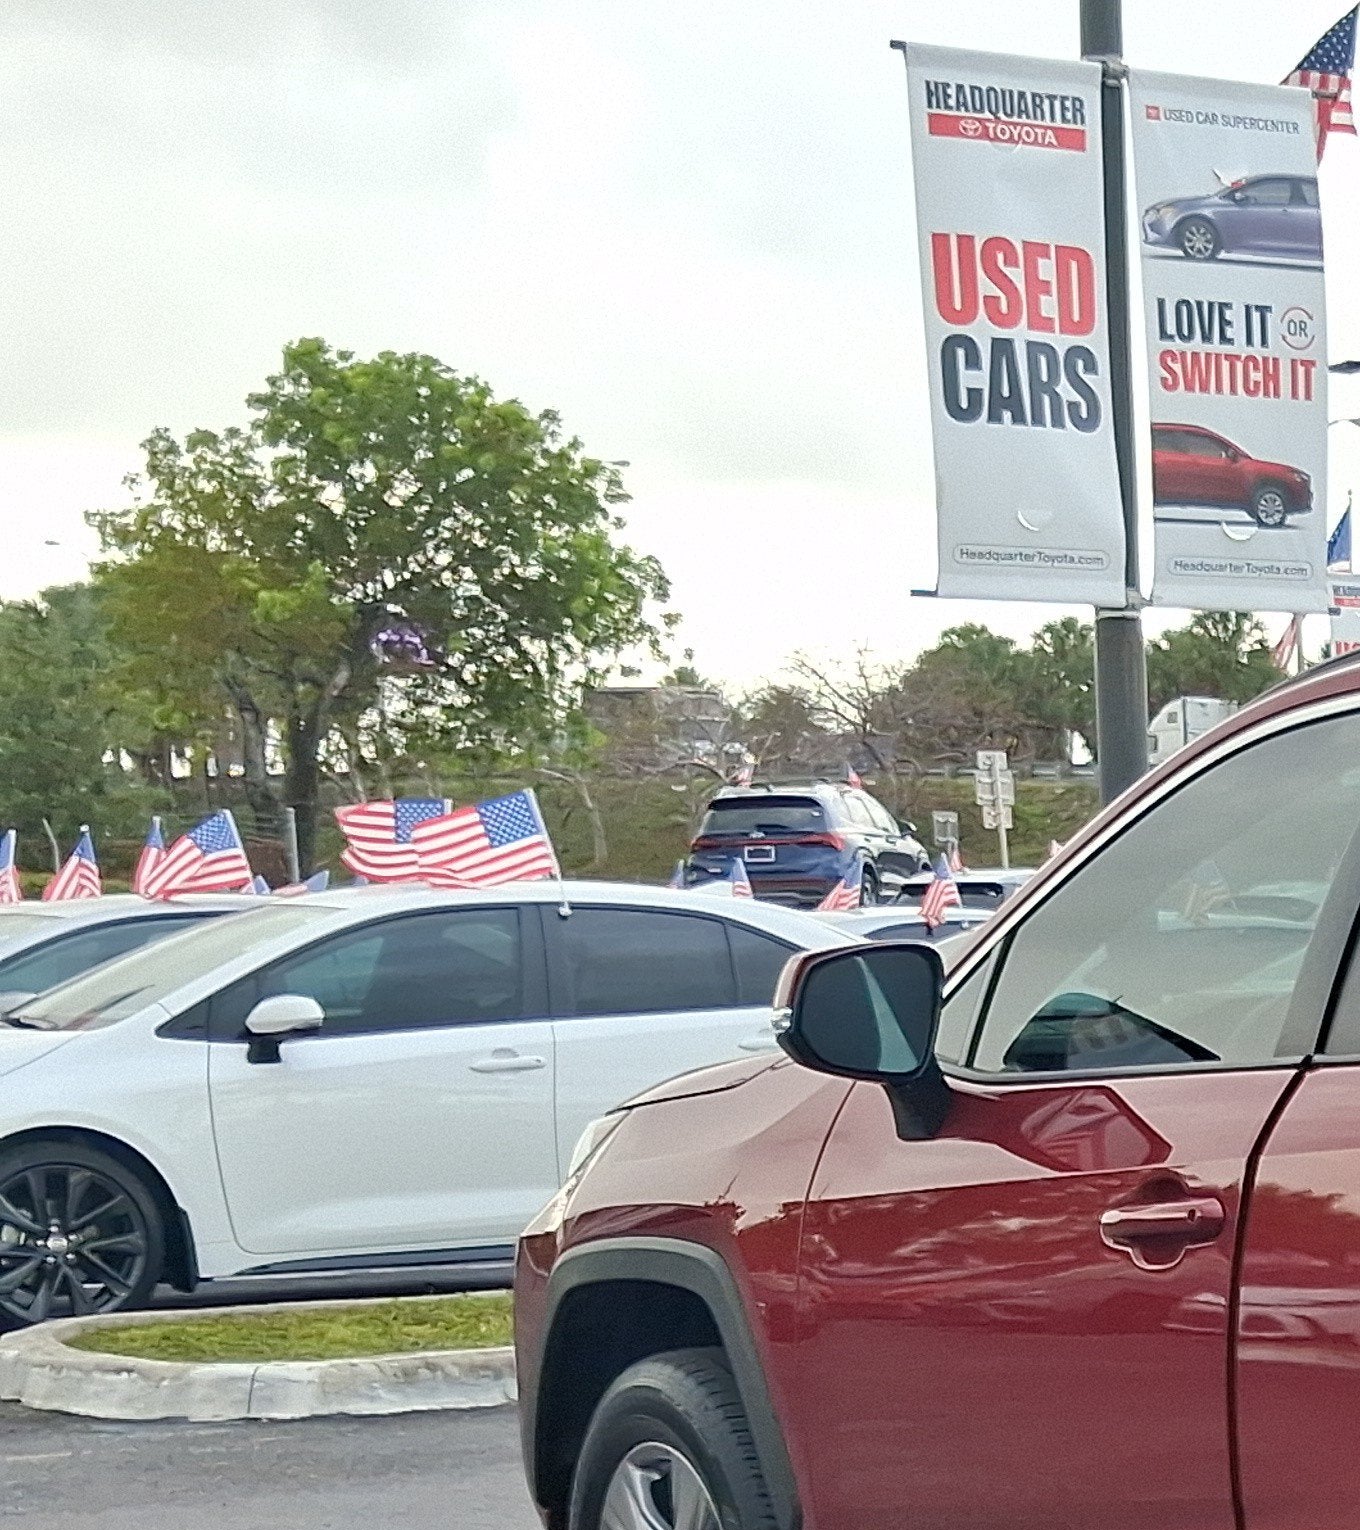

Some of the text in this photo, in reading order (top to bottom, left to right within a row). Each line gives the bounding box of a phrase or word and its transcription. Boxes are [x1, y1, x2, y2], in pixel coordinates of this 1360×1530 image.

[925, 79, 1086, 126] HEADQUARTER
[1164, 109, 1300, 135] USED CAR SUPERCENTER
[985, 121, 1059, 147] TOYOTA
[931, 232, 1096, 337] USED
[1156, 297, 1309, 349] LOVE IT OR
[940, 333, 1102, 434] CARS
[1158, 349, 1317, 401] SWITCH IT
[959, 547, 1105, 568] HeadquarterToyota.com
[1173, 559, 1308, 577] HeadquarterToyota.com
